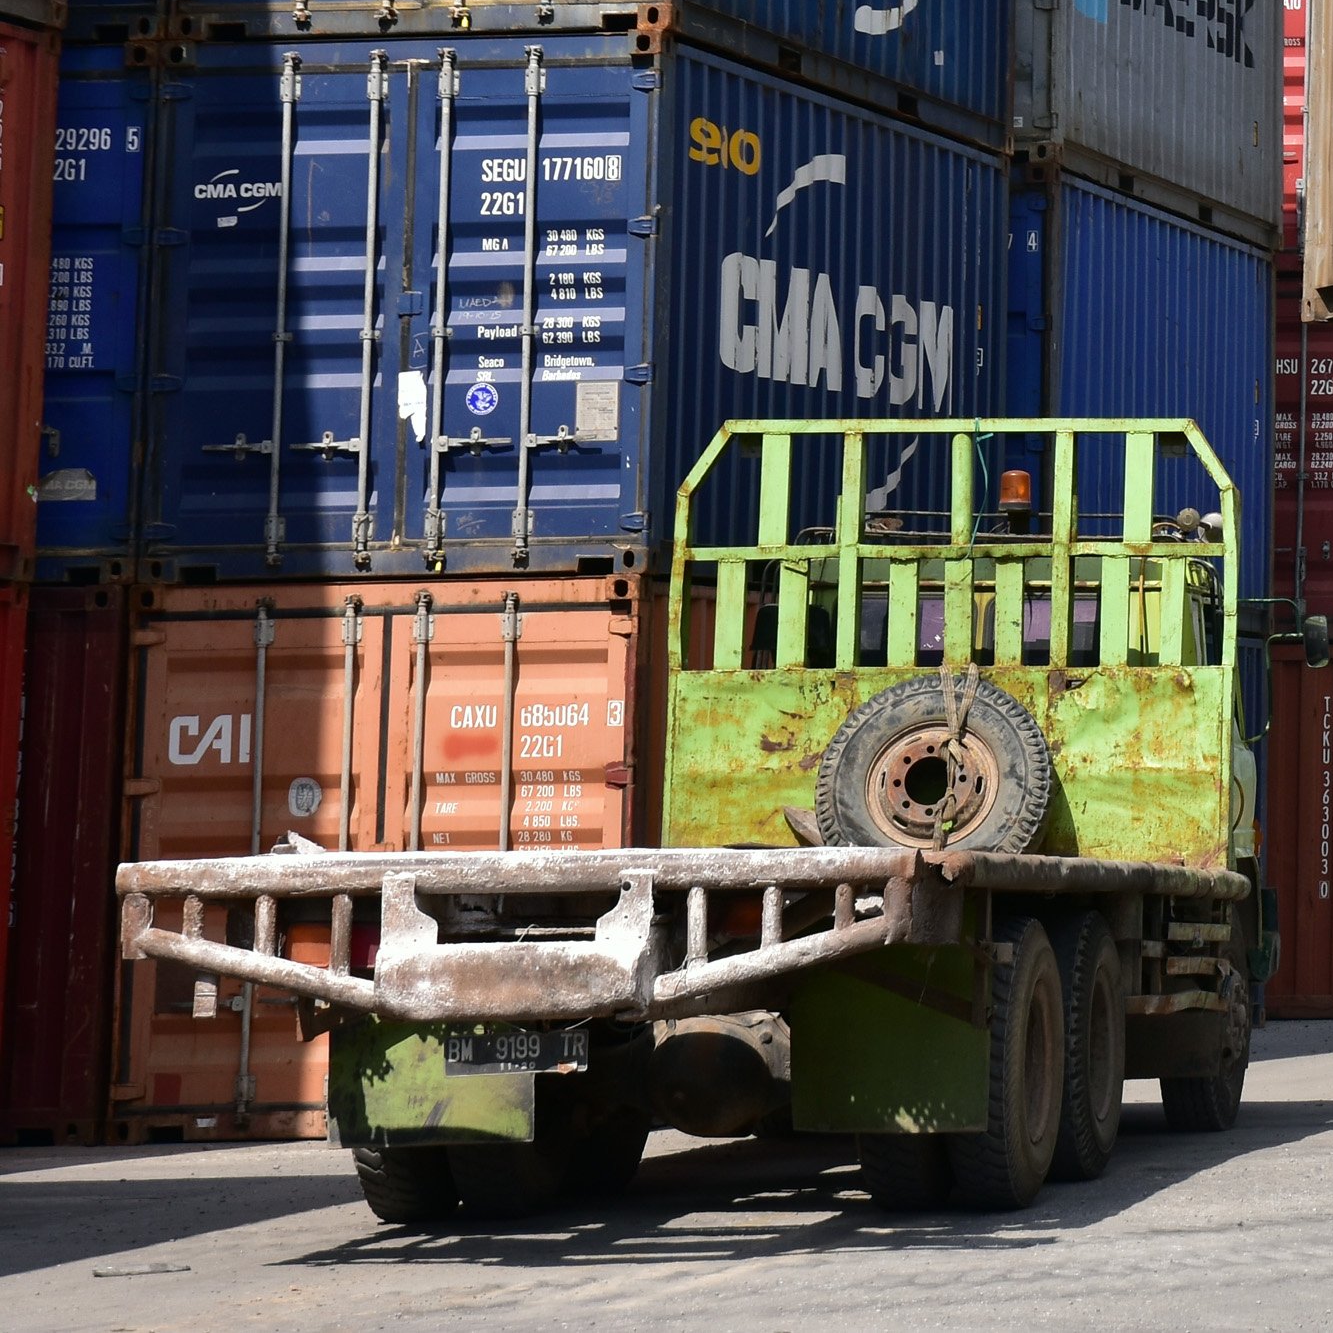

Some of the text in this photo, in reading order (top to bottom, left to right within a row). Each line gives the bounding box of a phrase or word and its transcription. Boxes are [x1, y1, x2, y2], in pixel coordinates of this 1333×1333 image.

[55, 128, 139, 150] 29296 5
[481, 159, 526, 182] SEGU
[542, 157, 604, 181] 177160
[194, 182, 282, 199] CMA CGM
[480, 192, 524, 216] 22G1
[586, 229, 605, 240] KGS
[586, 244, 605, 255] LBS
[583, 272, 602, 283] KGS
[585, 288, 603, 299] LBS
[582, 316, 601, 328] KGS
[477, 325, 517, 340] Payload
[582, 331, 600, 343] LBS
[719, 252, 953, 415] CMA CGM
[479, 355, 595, 369] Seaco Bridgetown,
[1276, 359, 1298, 374] HSU
[451, 702, 621, 728] CAXU 685064 3
[1322, 696, 1331, 765] TCKU
[168, 713, 252, 765] CAI
[520, 734, 563, 758] 22G1
[435, 773, 456, 783] MAX
[465, 772, 496, 783] GROSS
[521, 771, 554, 782] 30.480
[564, 786, 582, 797] LBS
[435, 801, 553, 814] TARE 2.200
[1321, 771, 1330, 875] 363003
[433, 833, 450, 844] NET
[449, 1033, 585, 1062] BM 9199 TR
